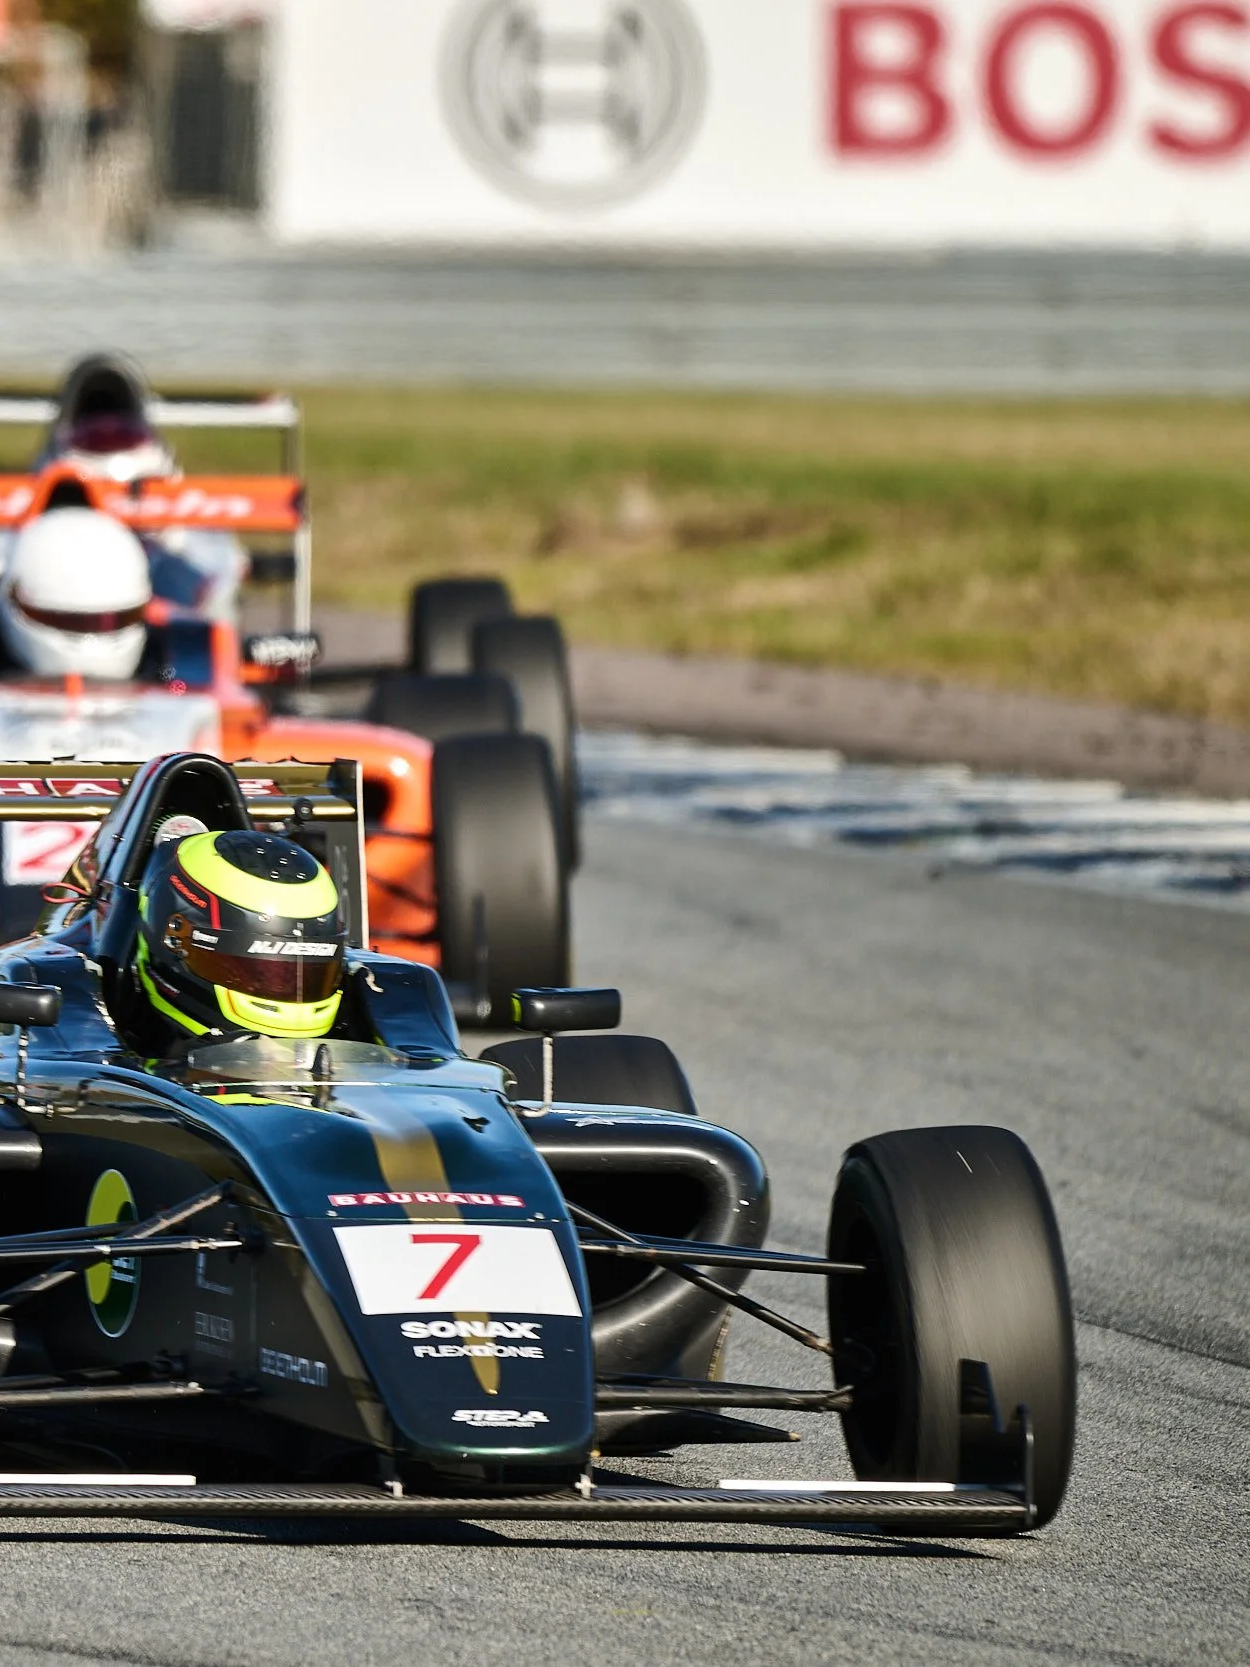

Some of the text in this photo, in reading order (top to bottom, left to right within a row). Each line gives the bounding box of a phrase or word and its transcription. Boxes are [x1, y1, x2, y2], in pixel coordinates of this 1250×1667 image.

[330, 1191, 525, 1208] BAUHAUS
[411, 1233, 482, 1299] 7
[400, 1320, 543, 1339] SONAX
